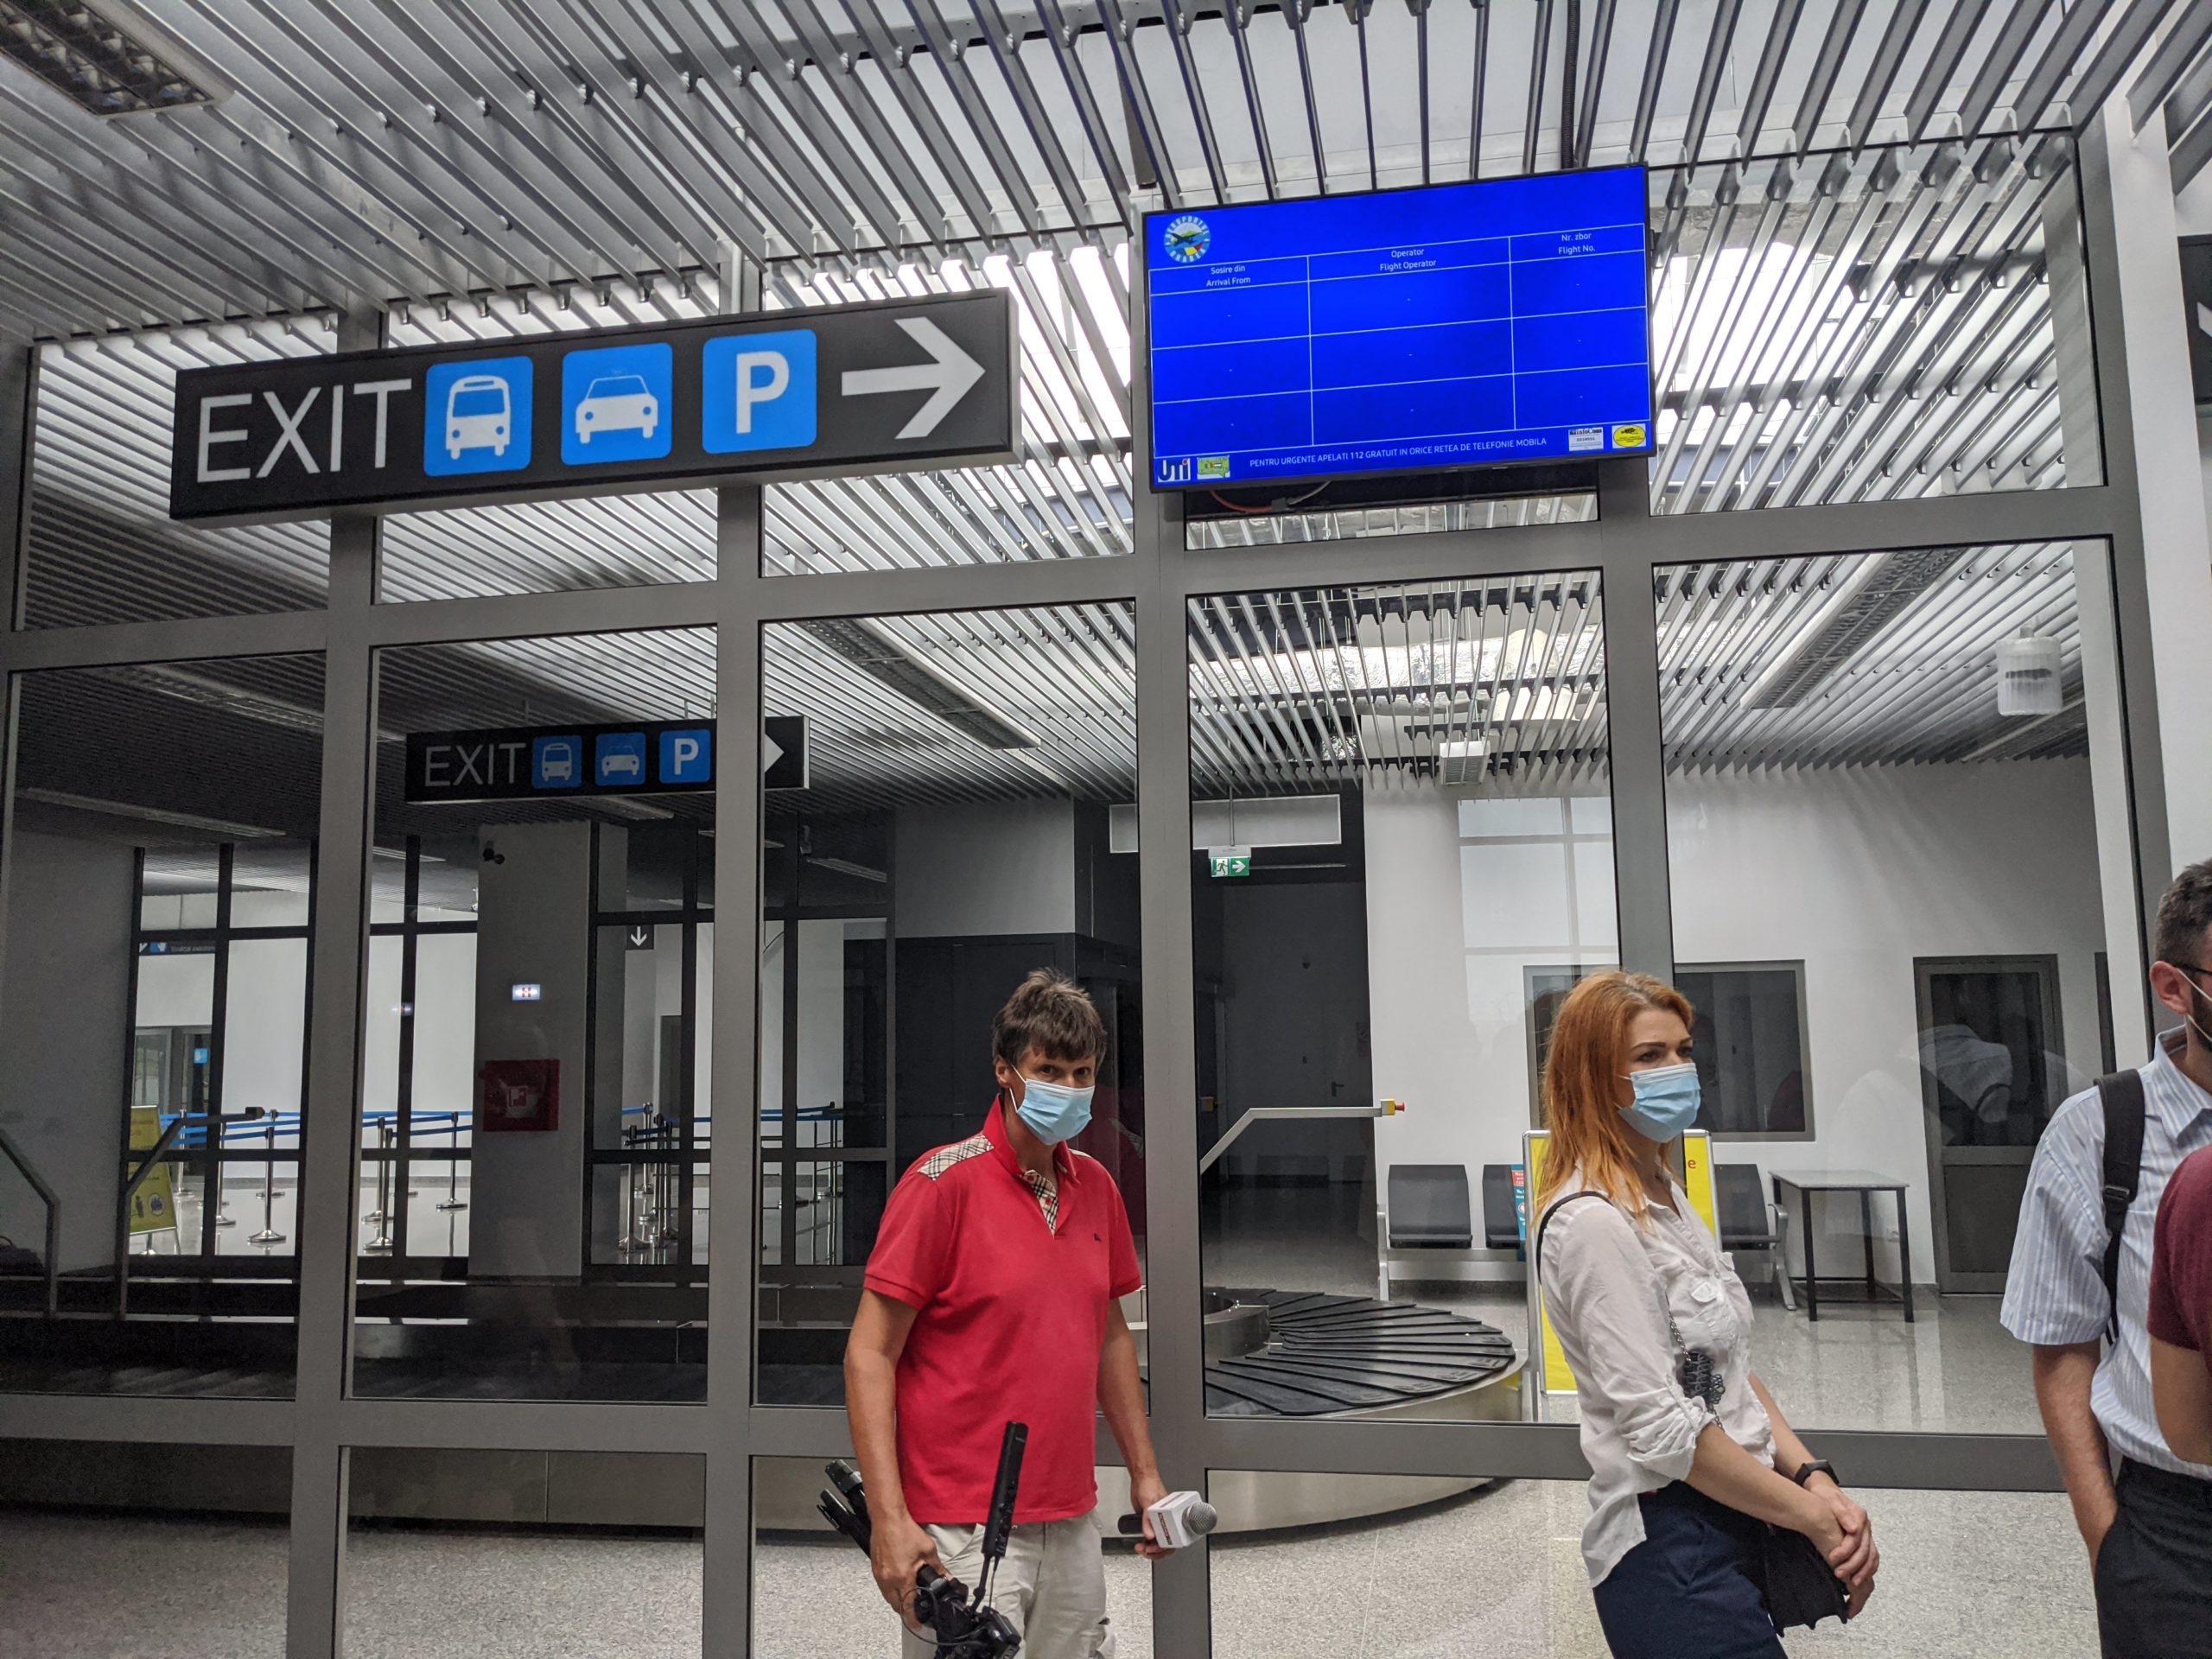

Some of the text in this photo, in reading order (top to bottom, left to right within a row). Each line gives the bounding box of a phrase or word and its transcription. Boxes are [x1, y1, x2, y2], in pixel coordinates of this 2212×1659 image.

[1391, 249, 1424, 258] Operator
[1558, 245, 1581, 255] Flight
[1211, 266, 1233, 275] Sosire
[1380, 260, 1437, 272] Flight Operator
[1206, 276, 1251, 287] Arrival From
[197, 351, 789, 483] EXIT P
[1249, 437, 1547, 467] PENTRU URGENTE APELATI 112 GRATUIT IN ORICE RETEA DE TELEFONIE MOBILA
[425, 738, 699, 786] EXIT P
